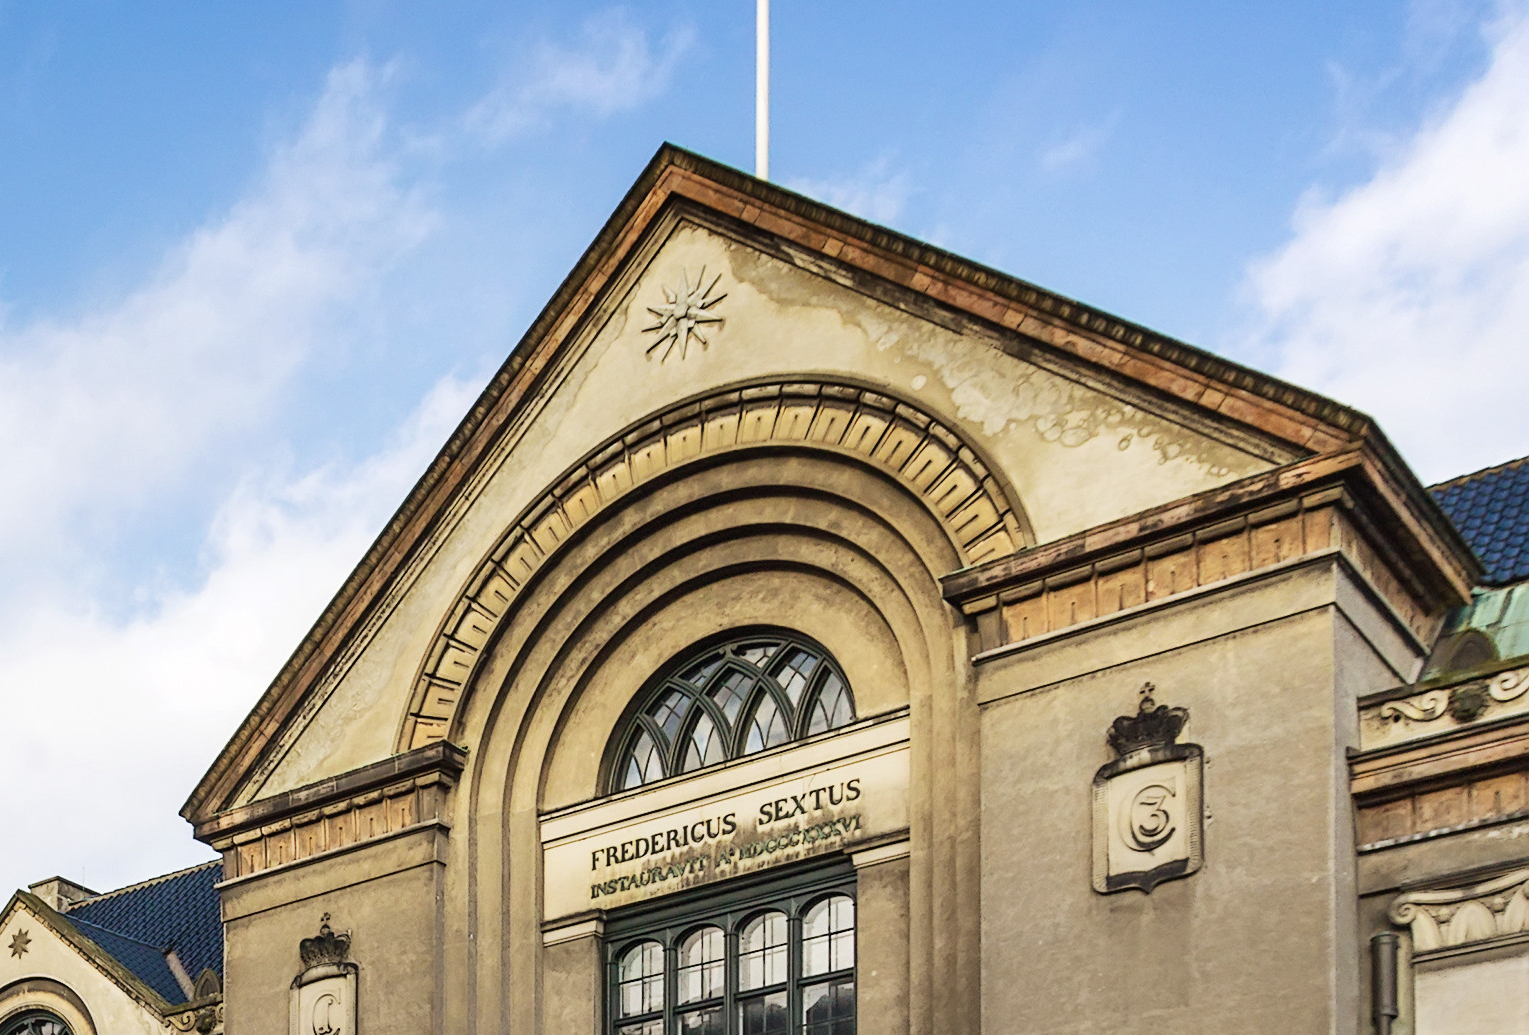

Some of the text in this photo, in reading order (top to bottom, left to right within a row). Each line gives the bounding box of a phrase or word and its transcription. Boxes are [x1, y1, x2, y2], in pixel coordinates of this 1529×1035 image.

[591, 778, 862, 871] FREDERICUS SEXTUS
[590, 854, 709, 900] INSTAURAVIT
